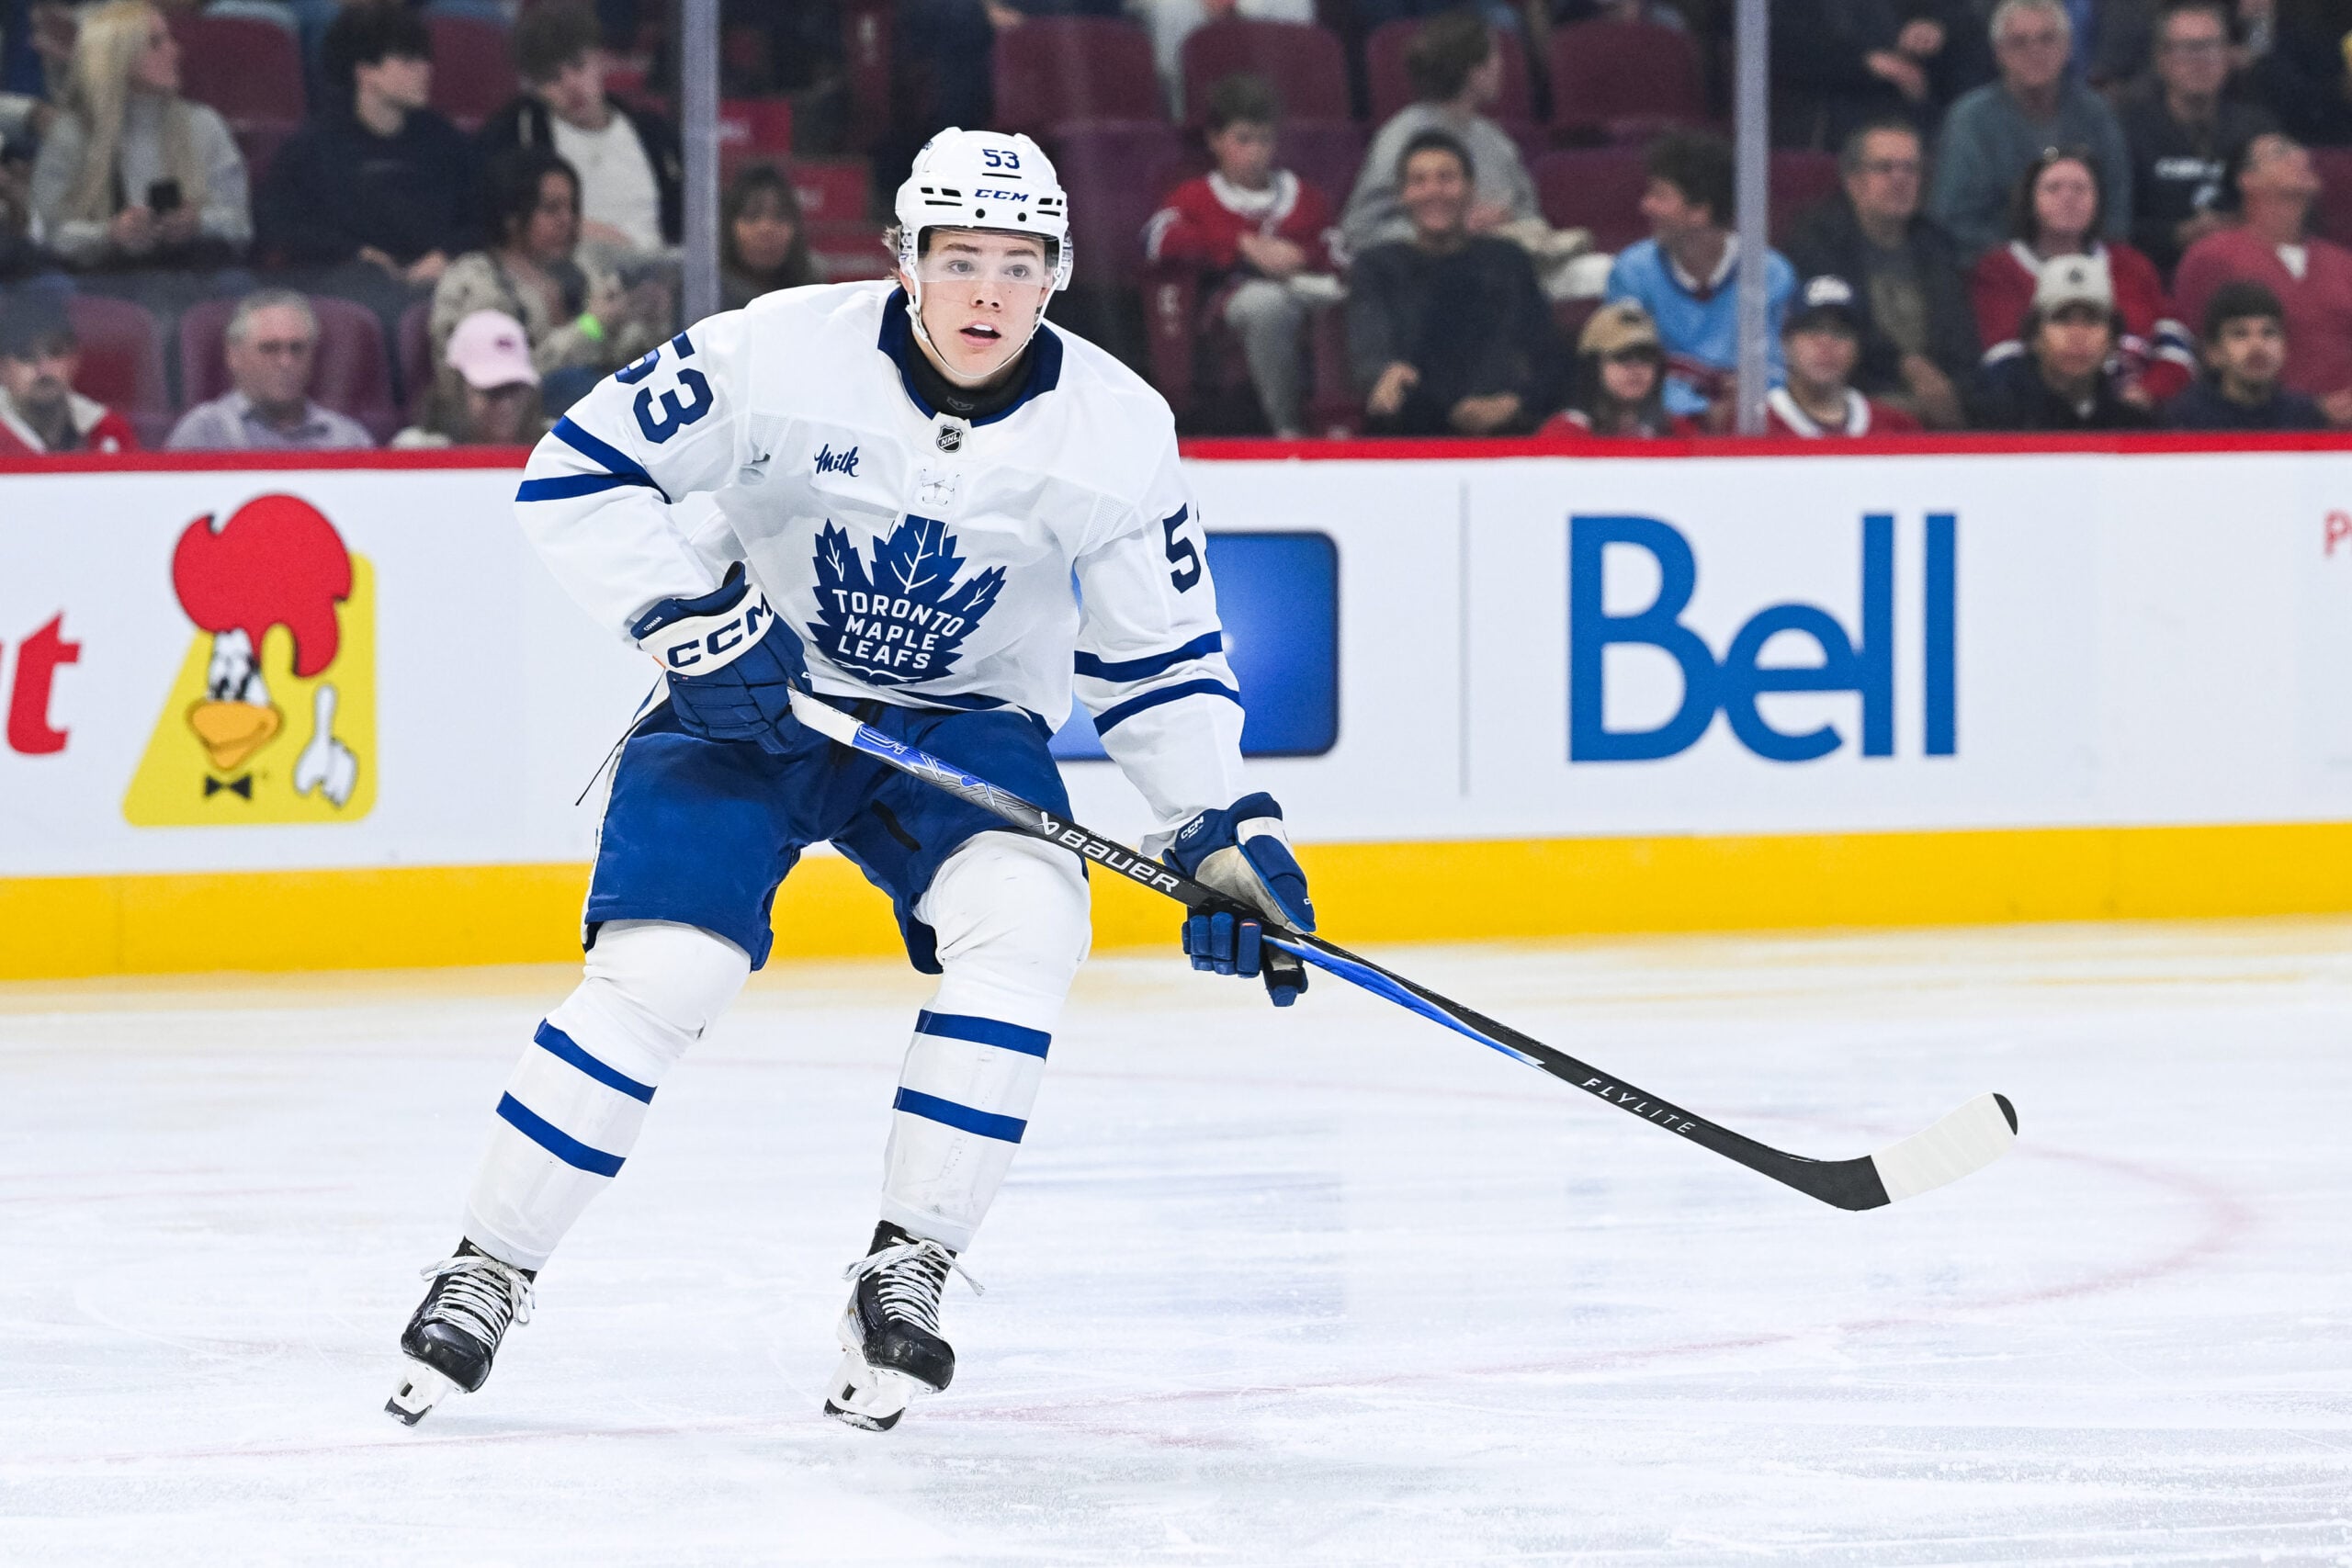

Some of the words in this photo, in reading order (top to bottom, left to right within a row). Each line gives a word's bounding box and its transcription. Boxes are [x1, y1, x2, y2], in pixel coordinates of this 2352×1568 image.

[982, 149, 1021, 170] 53
[974, 188, 1029, 202] CCM
[941, 434, 958, 446] NHL
[814, 444, 860, 478] Milk
[1162, 502, 1201, 594] 5
[667, 591, 774, 669] CCM
[831, 588, 965, 637] TORONTO
[844, 614, 939, 650] MAPLE
[1570, 513, 1956, 762] Bell
[837, 635, 931, 669] LEAFS
[0, 610, 81, 756] t
[1181, 815, 1204, 840] CCM
[1580, 1077, 1696, 1134] FLYLITE
